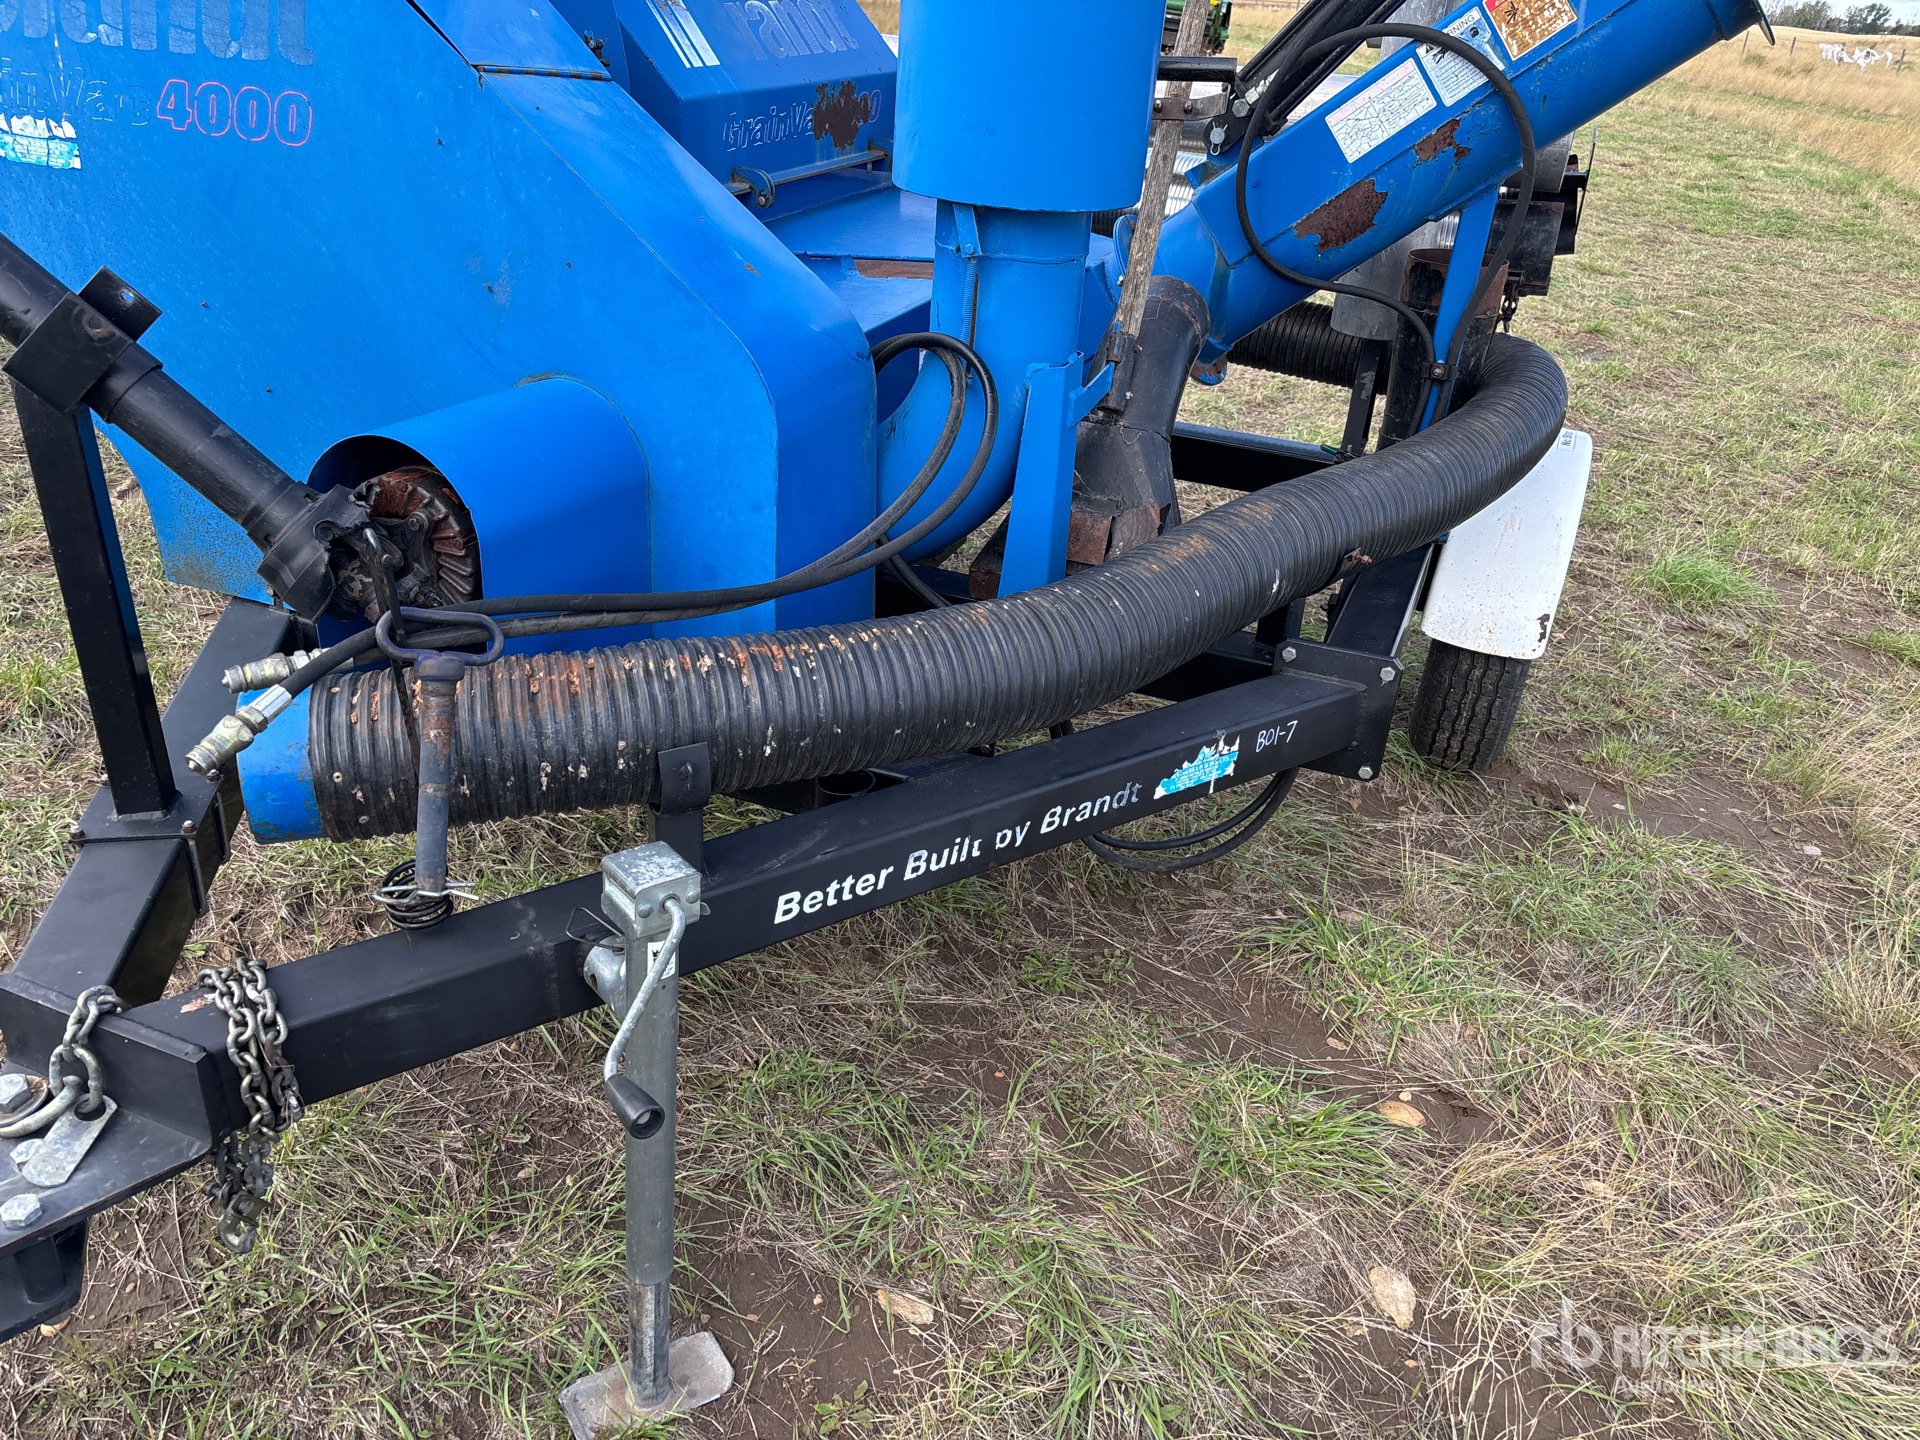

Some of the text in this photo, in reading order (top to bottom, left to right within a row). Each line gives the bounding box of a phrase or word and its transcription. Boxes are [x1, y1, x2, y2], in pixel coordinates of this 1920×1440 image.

[722, 0, 860, 61] randt
[157, 79, 312, 146] 4000
[722, 101, 815, 152] GrainVa
[773, 865, 895, 925] Better
[903, 835, 983, 881] Built
[1039, 780, 1143, 835] Brandt
